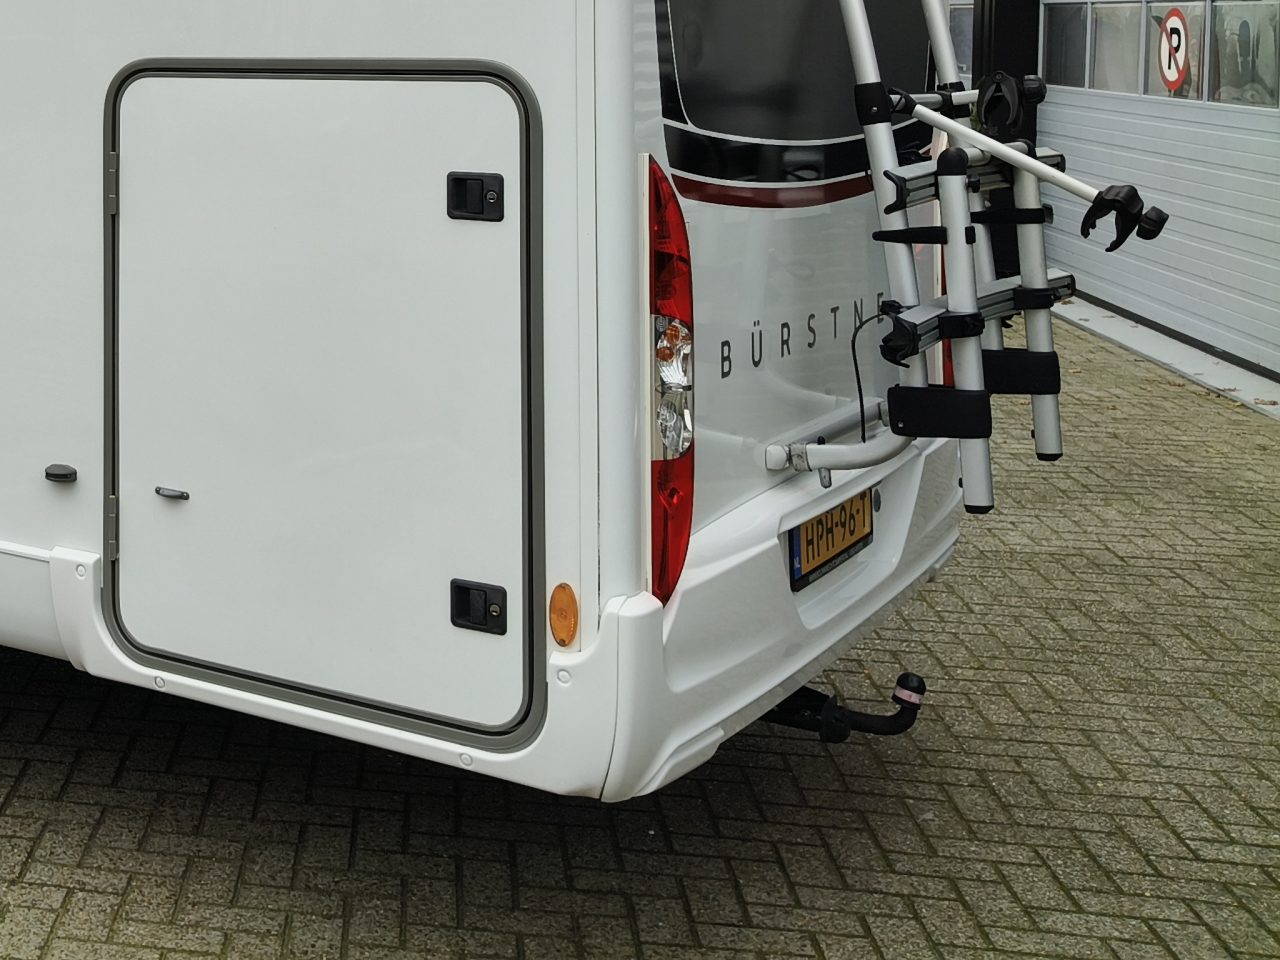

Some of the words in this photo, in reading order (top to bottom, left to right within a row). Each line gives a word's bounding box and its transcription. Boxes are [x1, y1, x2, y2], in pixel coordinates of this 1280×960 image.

[1167, 26, 1182, 71] P
[721, 292, 886, 379] BÜRSTNE
[805, 491, 867, 565] HPH-96-T
